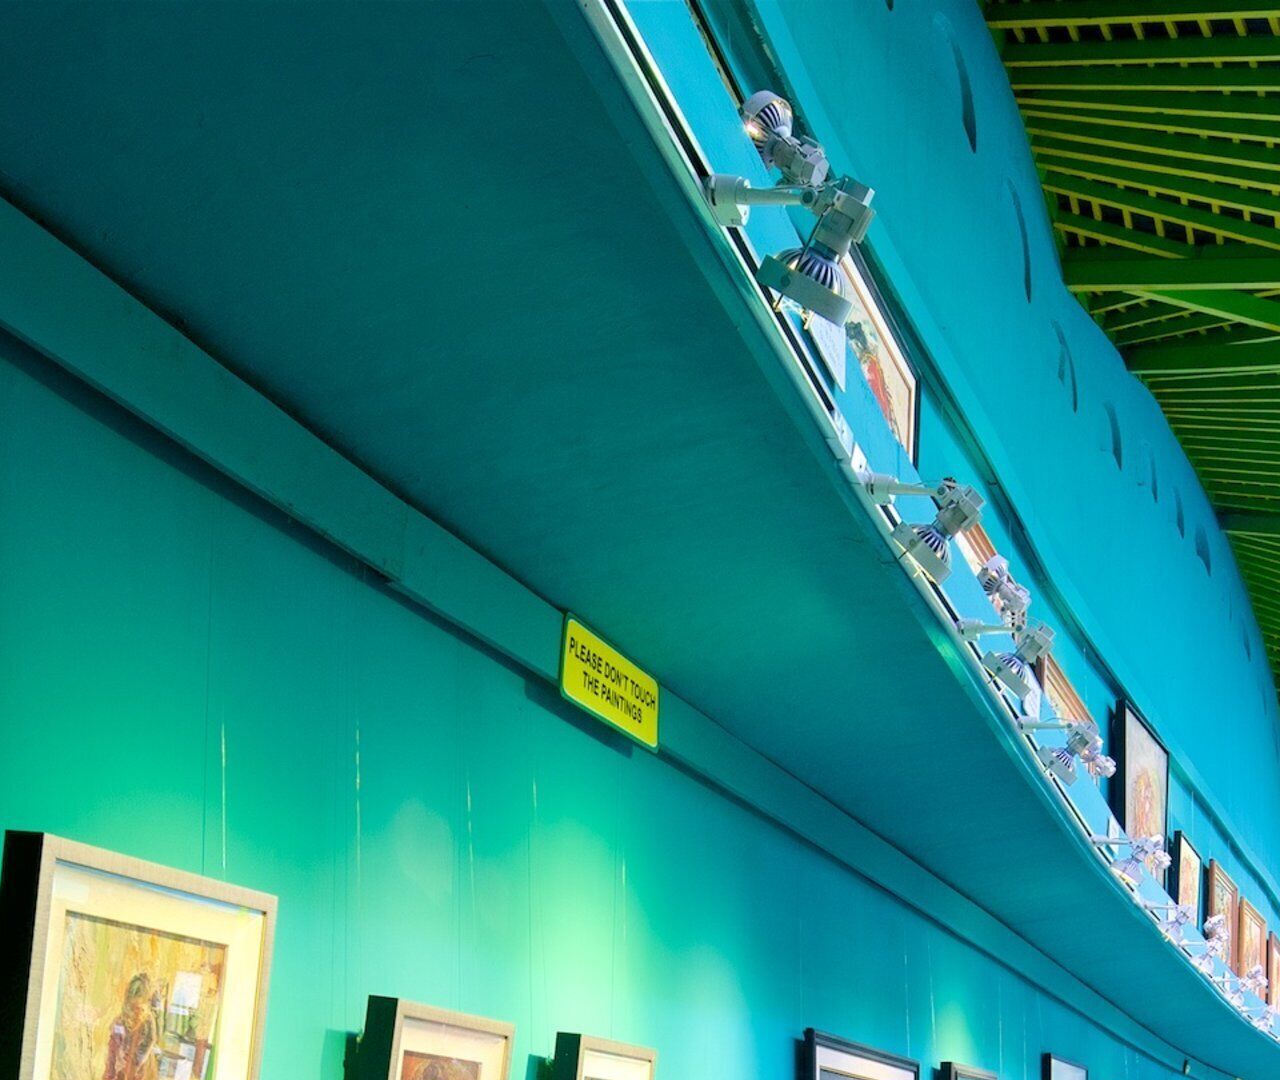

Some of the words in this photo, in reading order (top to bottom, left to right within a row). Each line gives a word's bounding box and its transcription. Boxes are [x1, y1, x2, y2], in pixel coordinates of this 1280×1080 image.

[569, 636, 602, 674] PLEASE
[604, 662, 629, 692] DON'T
[630, 679, 656, 711] TOUCH
[583, 671, 599, 697] THE
[601, 684, 642, 723] PAINTINGS
